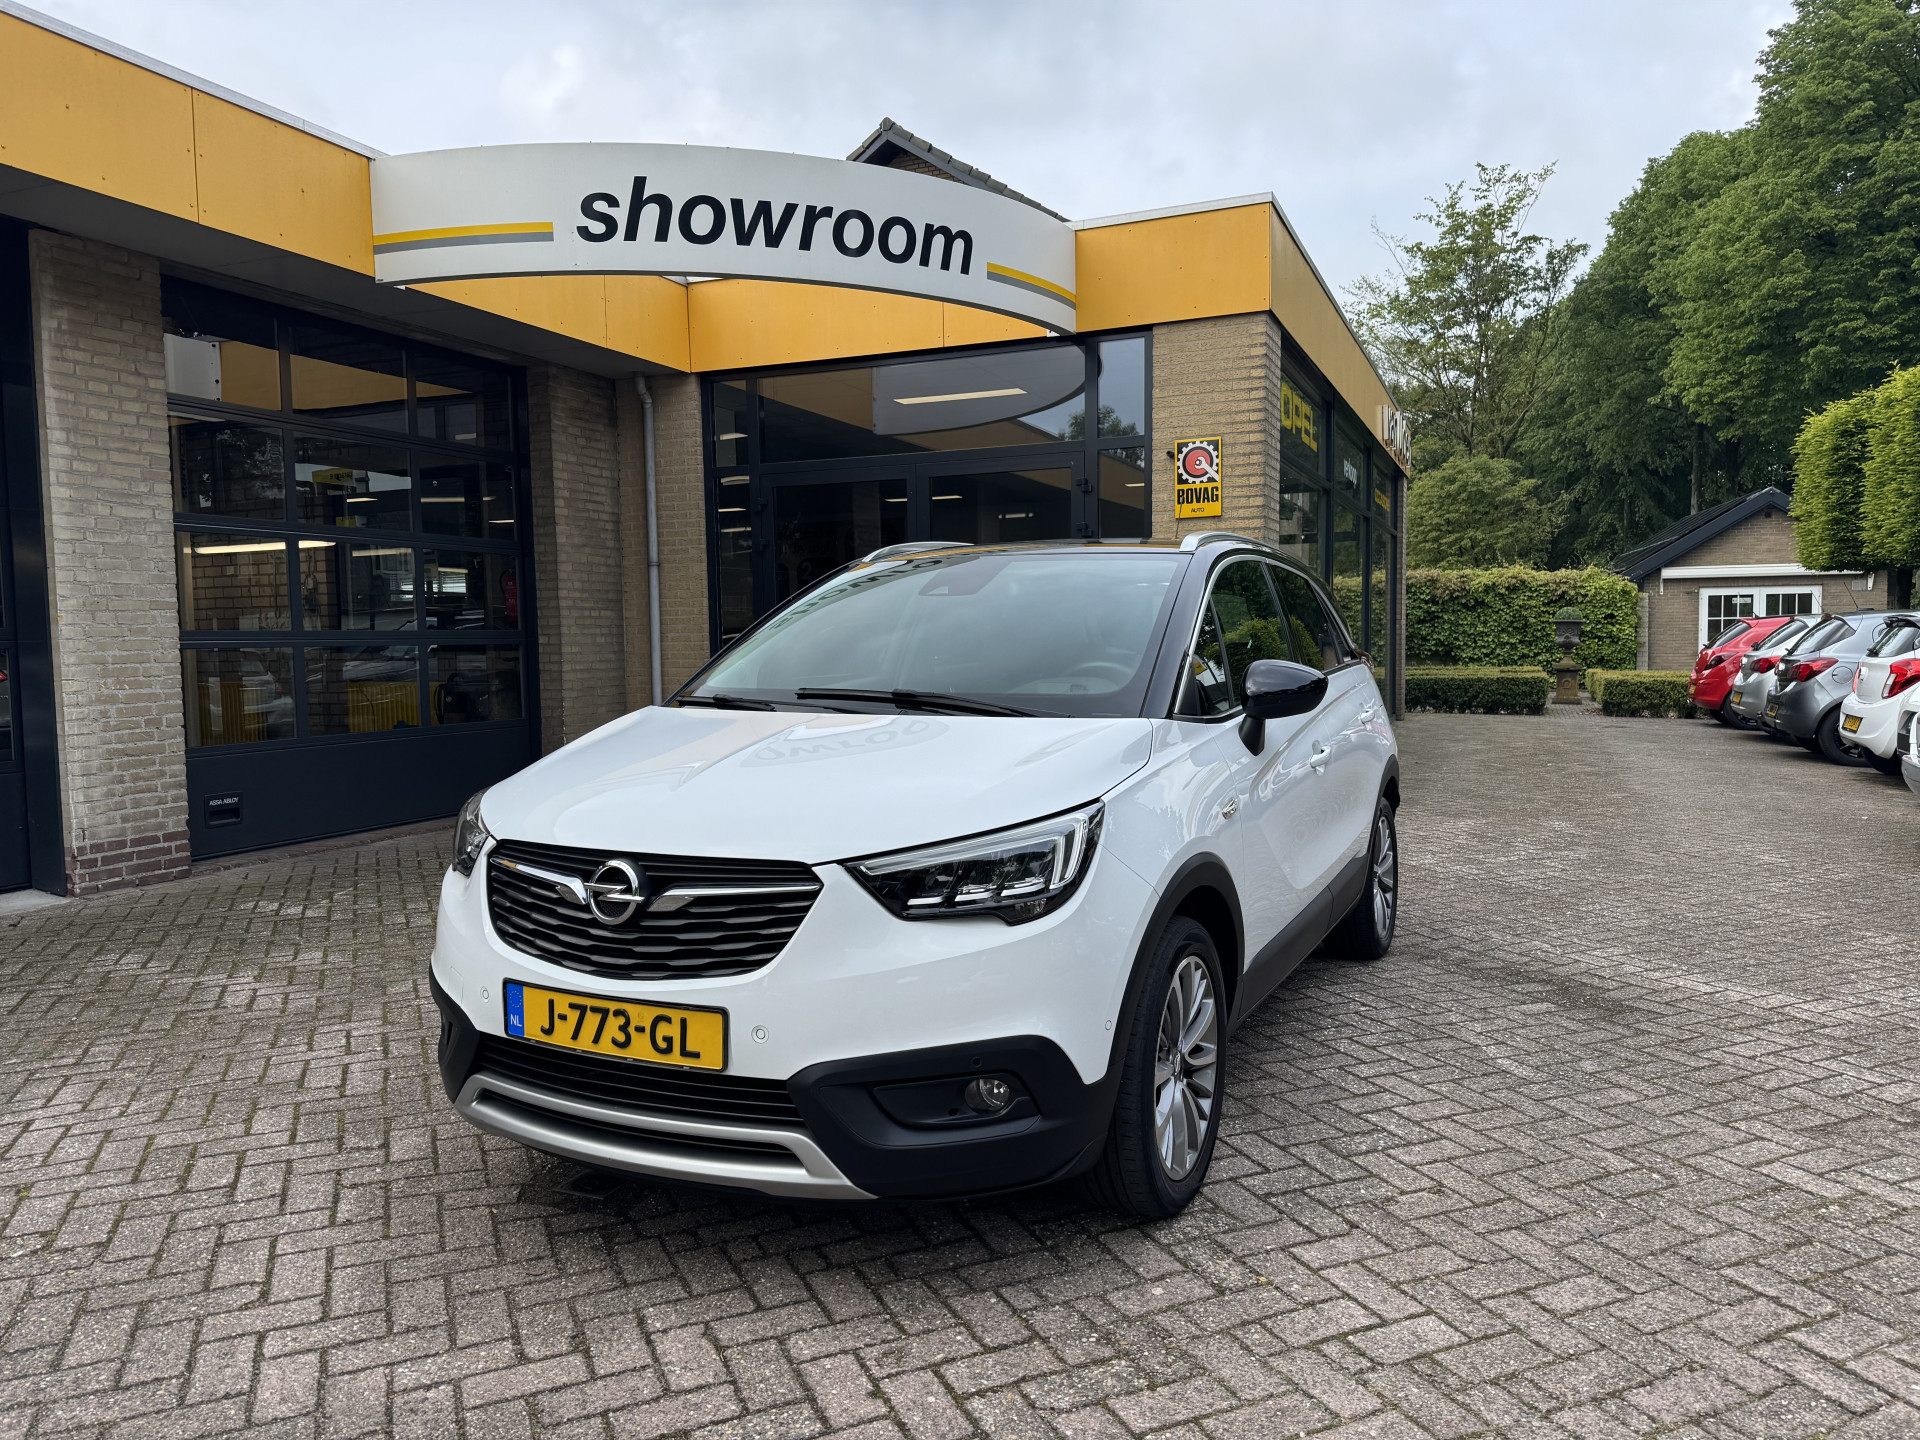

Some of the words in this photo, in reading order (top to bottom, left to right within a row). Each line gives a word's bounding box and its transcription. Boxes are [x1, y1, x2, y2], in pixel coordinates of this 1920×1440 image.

[576, 175, 974, 275] showroom
[1280, 382, 1318, 453] OPEL
[1177, 486, 1219, 505] BOVAG
[510, 1013, 523, 1028] NL
[540, 998, 701, 1059] J-773-GL
